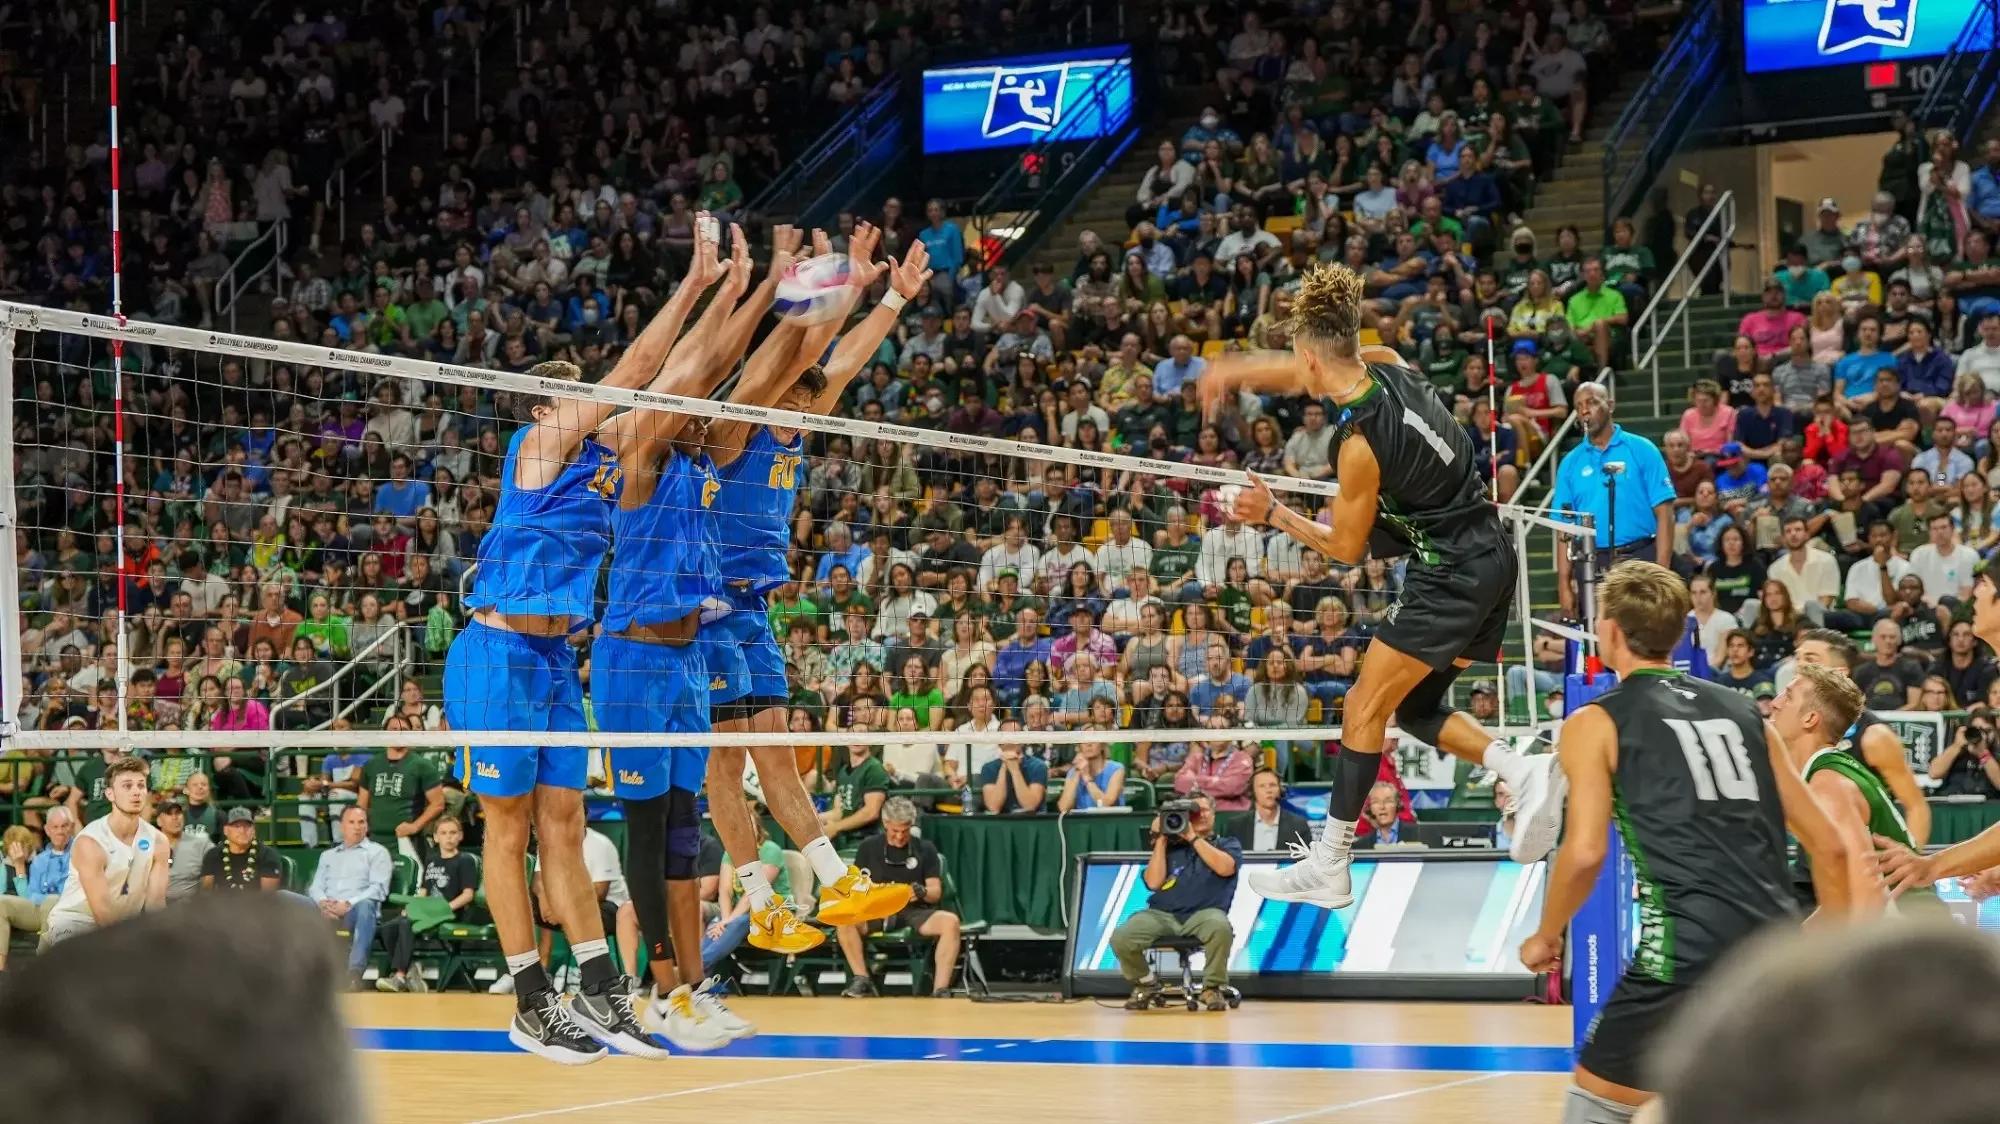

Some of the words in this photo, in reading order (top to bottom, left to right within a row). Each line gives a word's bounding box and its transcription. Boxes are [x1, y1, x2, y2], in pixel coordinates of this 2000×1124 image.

[216, 337, 243, 348] VOLLEYBALL
[243, 340, 278, 352] CHAMPIONSHIP
[335, 353, 359, 364] VOLLEYBALL
[359, 356, 392, 367] CHAMPIONSHIP
[443, 368, 466, 378] VOLLEYBALL
[1403, 407, 1456, 467] 1
[768, 453, 802, 490] 20
[709, 675, 728, 691] cla
[1661, 718, 1760, 801] 10
[476, 761, 500, 779] Ucla
[618, 769, 644, 785] Ucla
